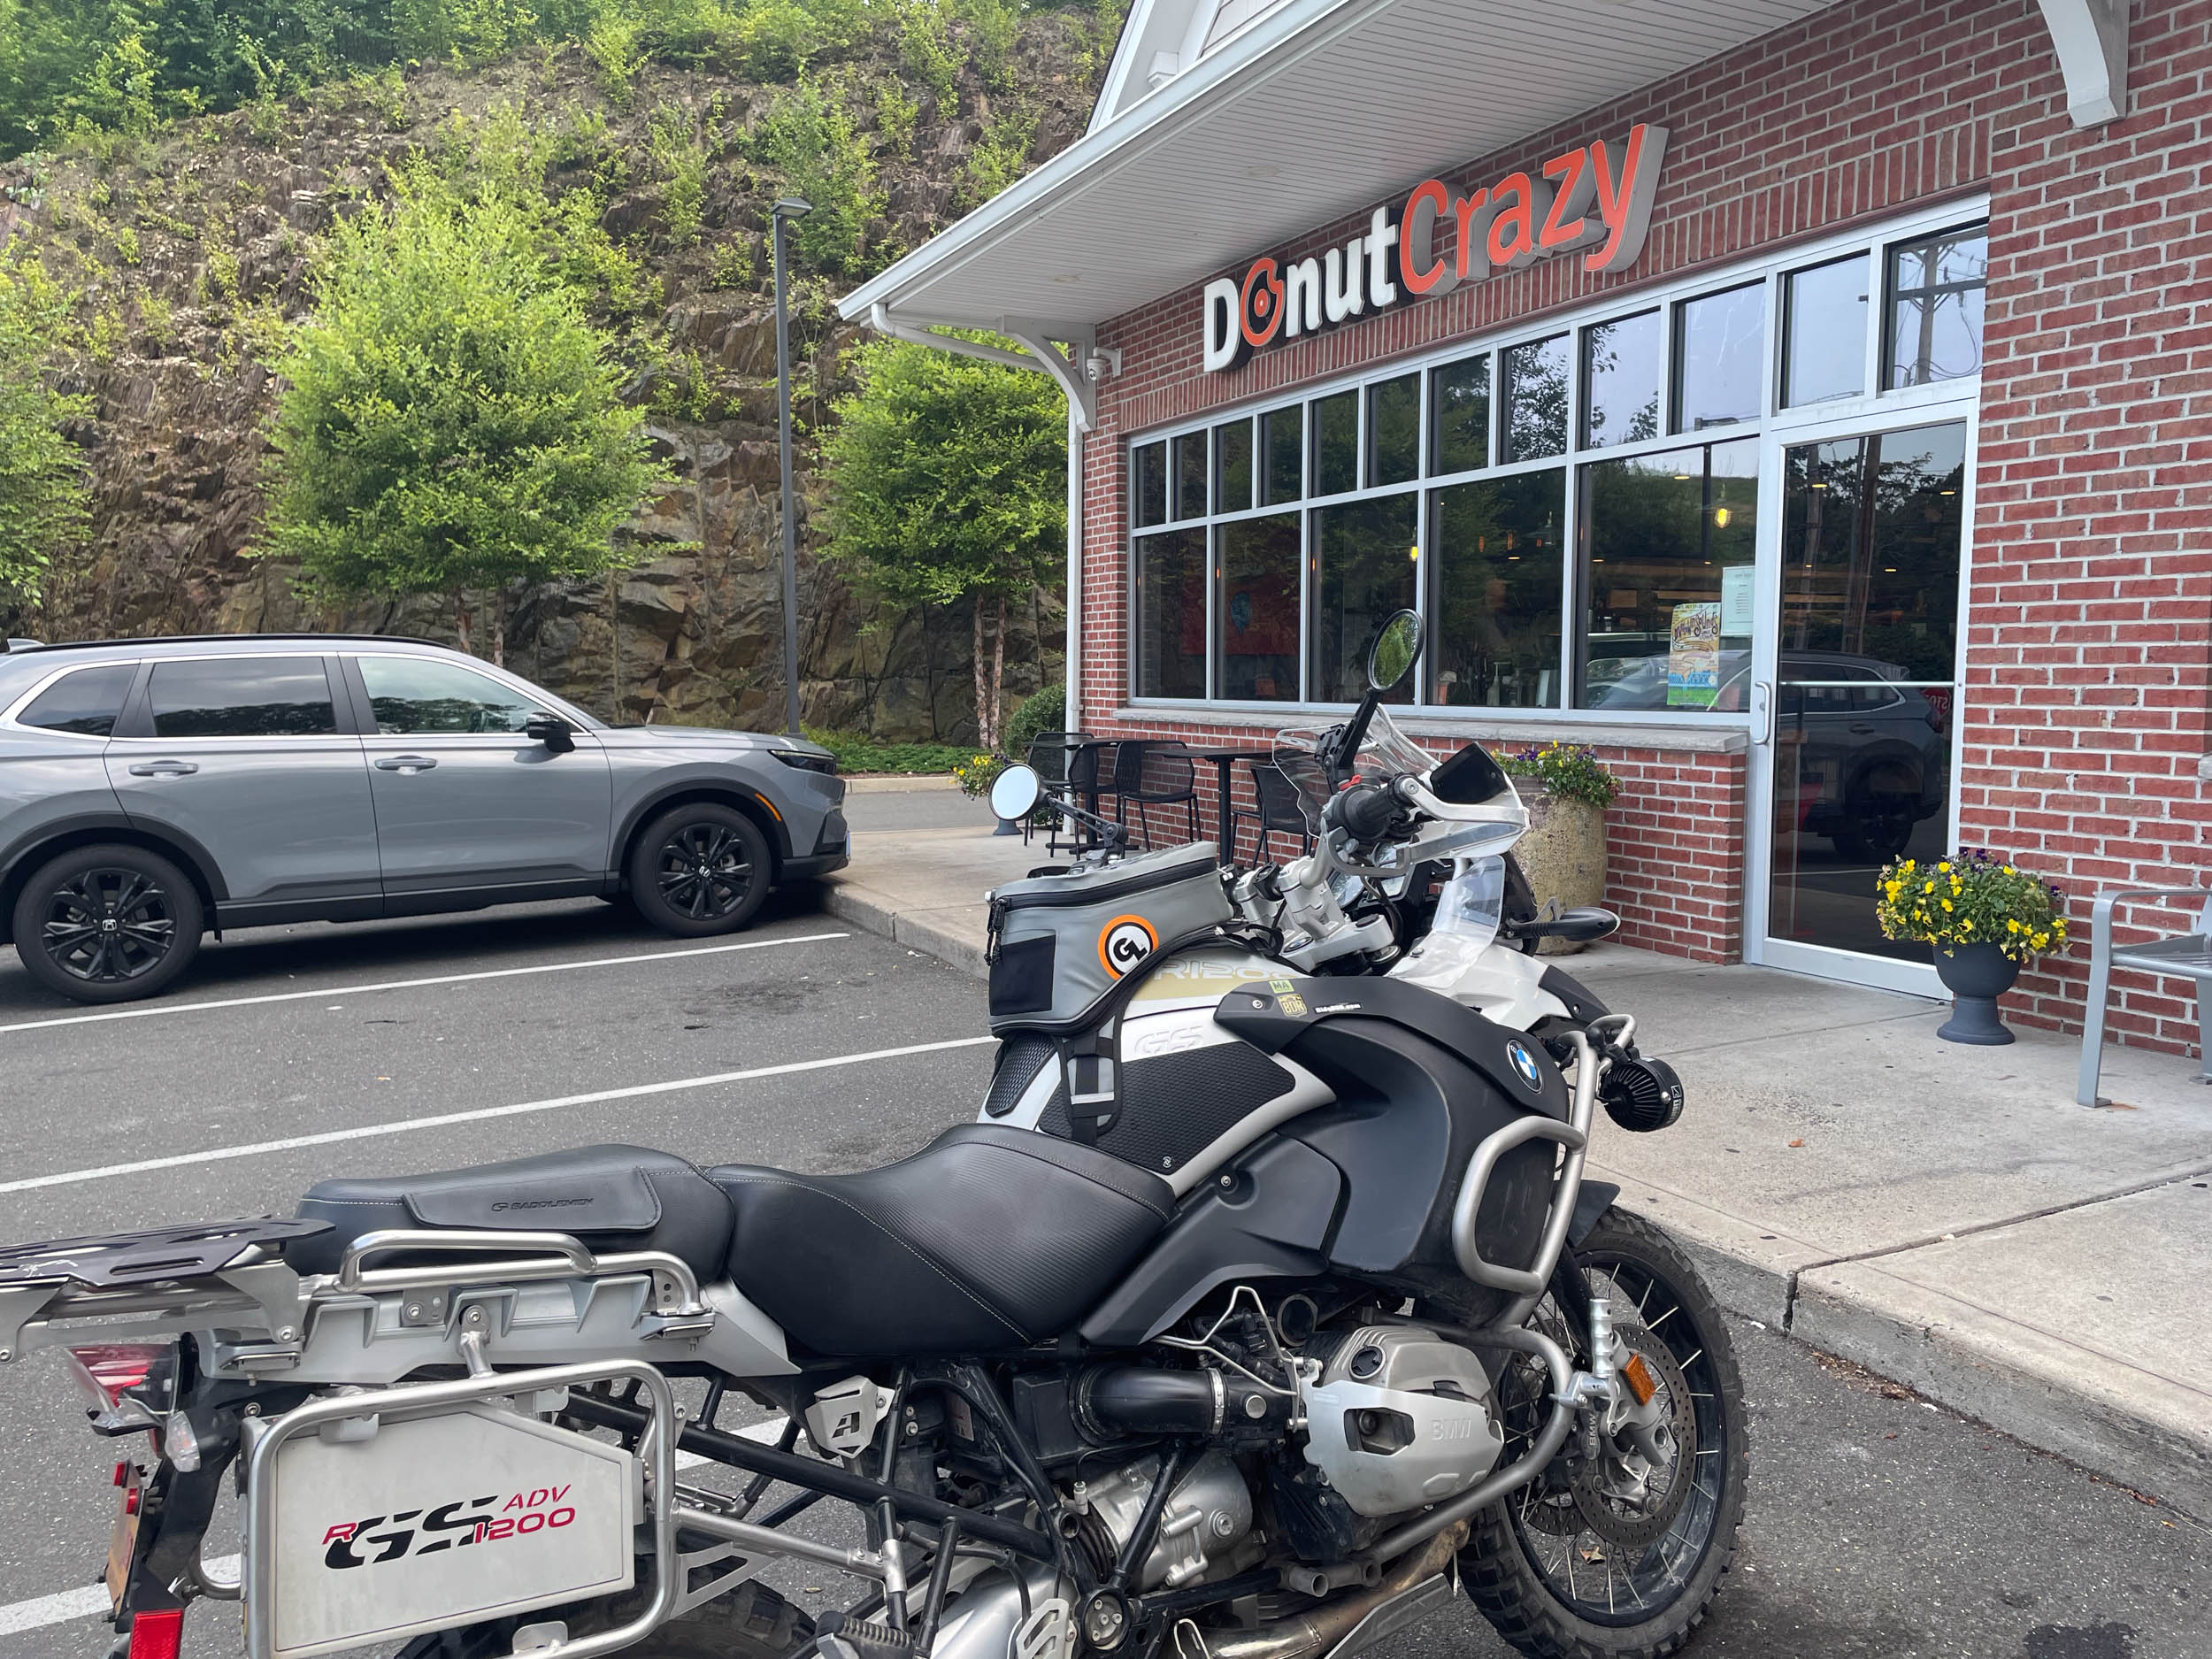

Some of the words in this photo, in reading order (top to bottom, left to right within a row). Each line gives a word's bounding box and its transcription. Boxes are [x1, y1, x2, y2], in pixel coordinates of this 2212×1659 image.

[1399, 123, 1653, 295] Crazy
[1282, 1000, 1305, 1013] BDR
[1134, 1025, 1203, 1054] GS
[1430, 1417, 1472, 1441] BMW
[503, 1484, 572, 1512] ADV
[474, 1507, 576, 1544] 1200
